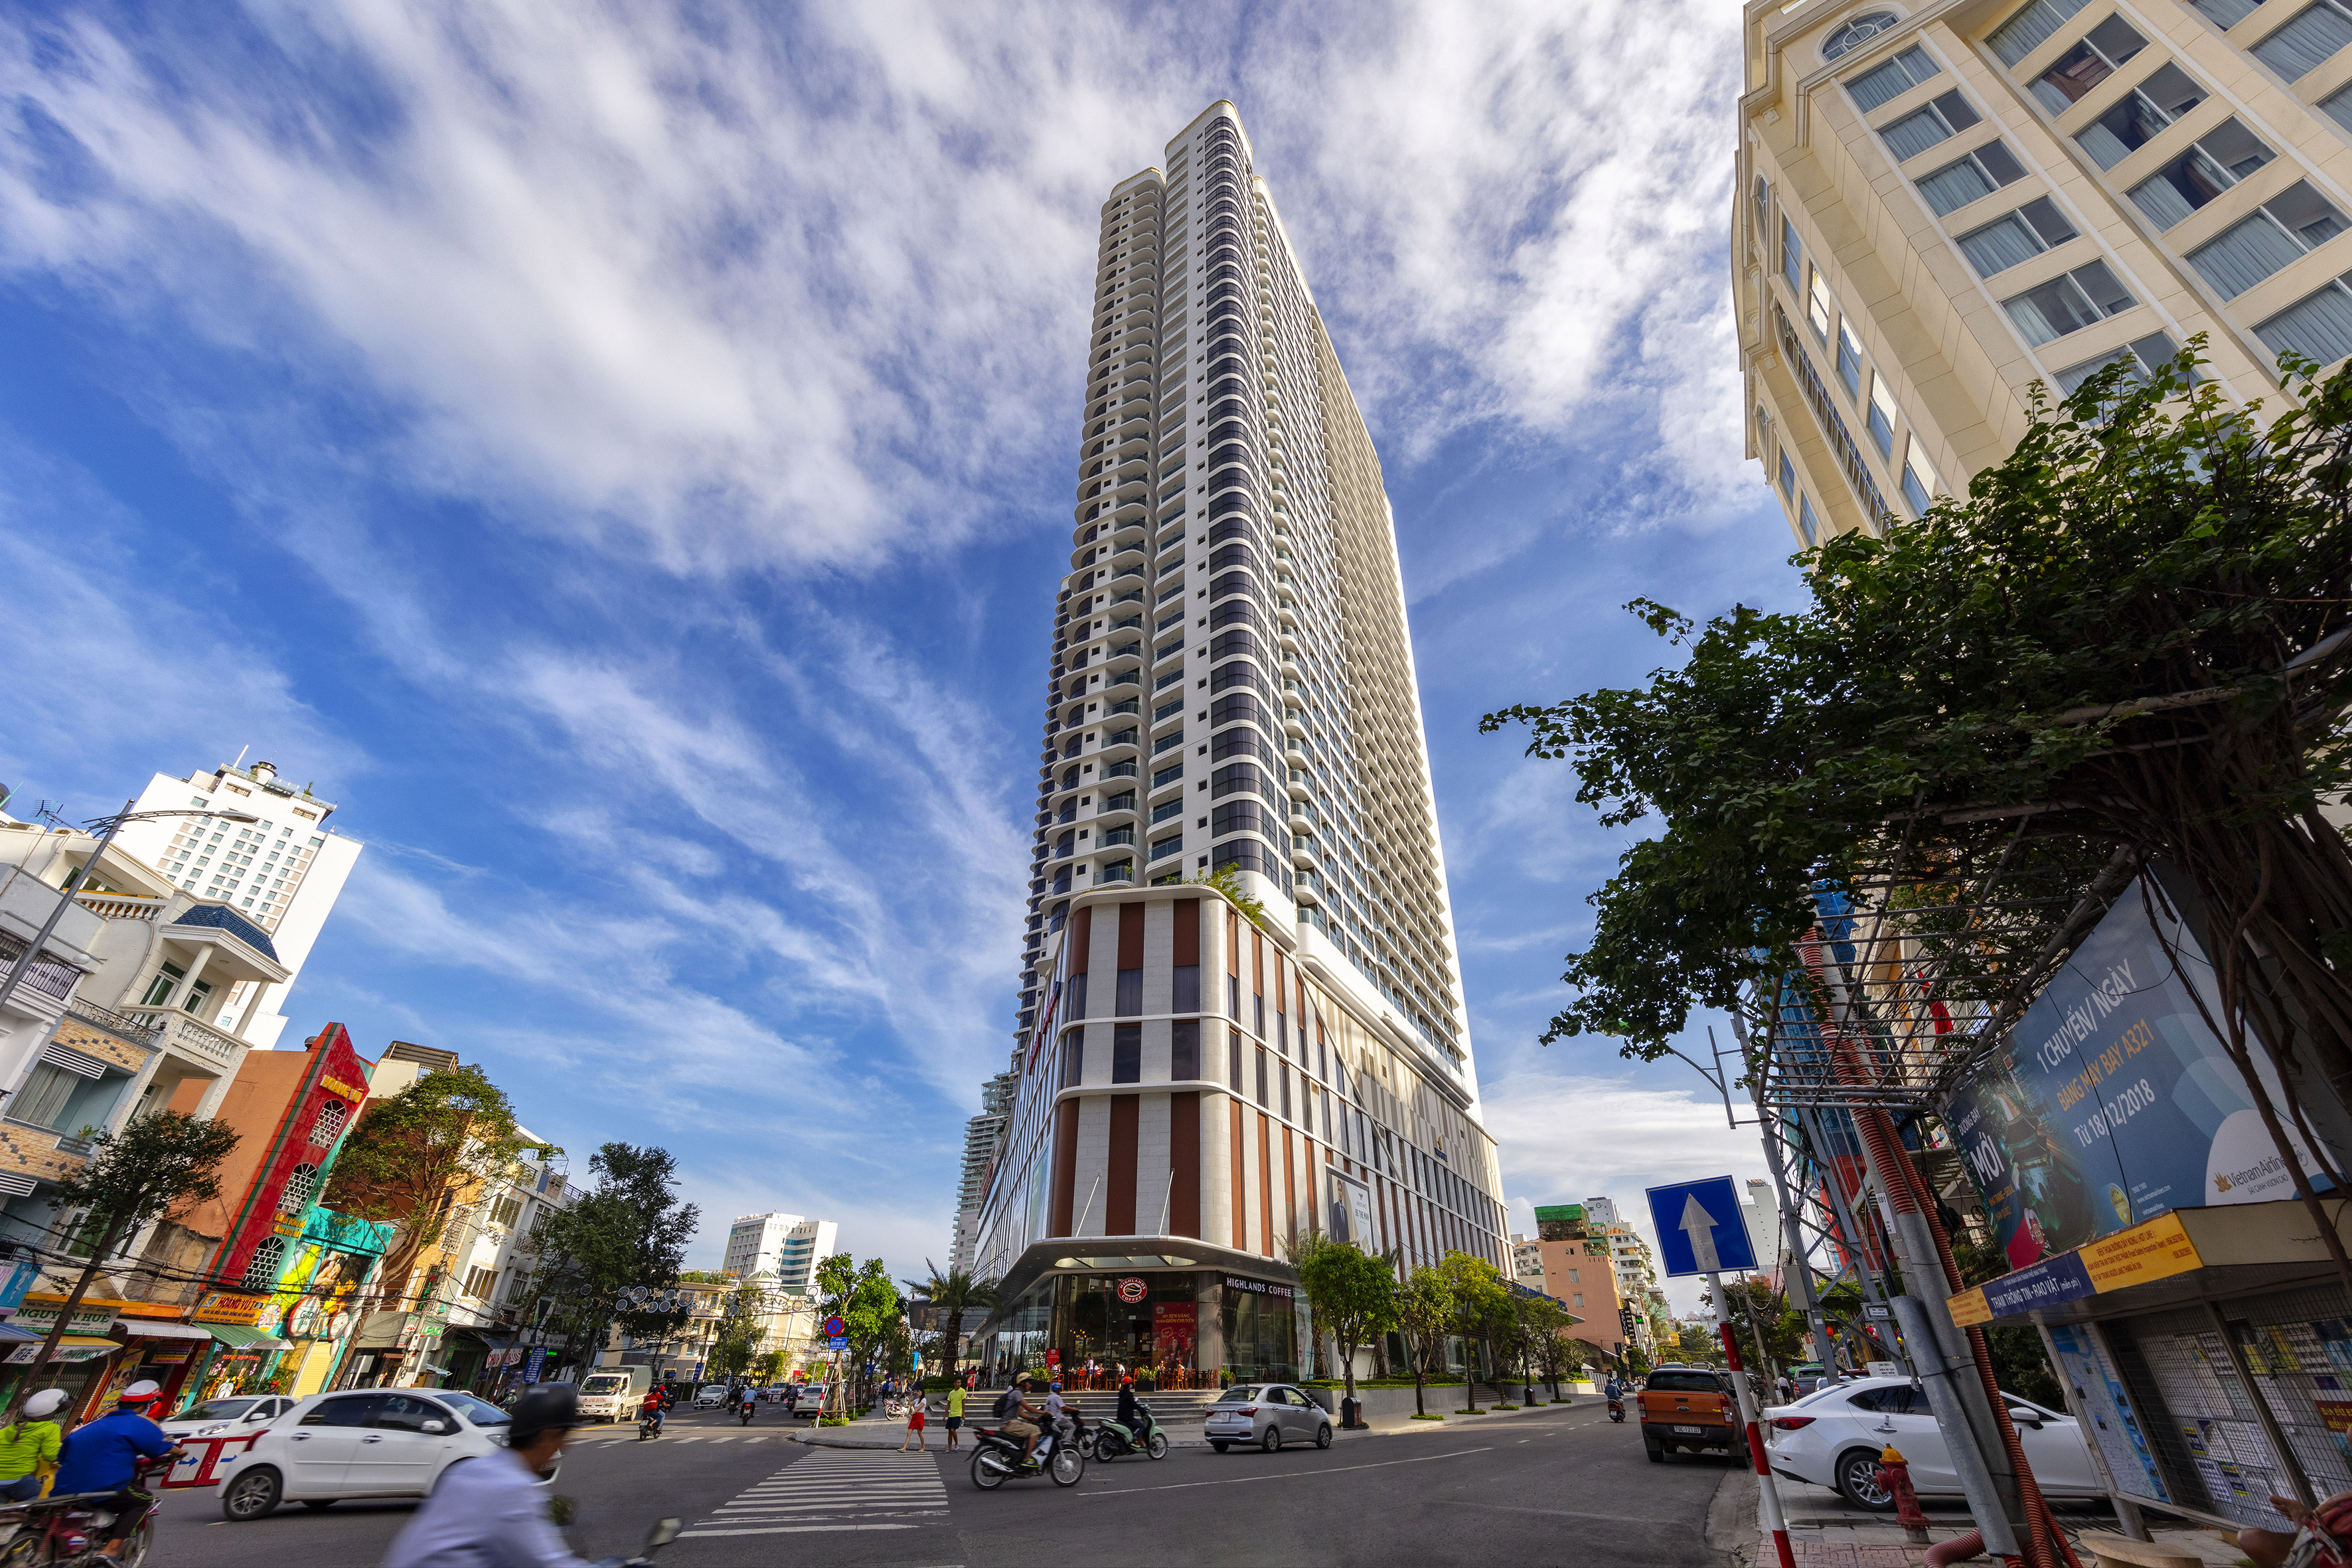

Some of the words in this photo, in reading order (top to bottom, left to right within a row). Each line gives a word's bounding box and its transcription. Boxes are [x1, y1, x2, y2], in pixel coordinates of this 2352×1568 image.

[2037, 1052, 2049, 1073] 1
[2092, 958, 2137, 1018] NGÀY
[2079, 1061, 2104, 1093] MÁY
[2099, 1041, 2124, 1075] BAY
[2121, 1018, 2154, 1059] A321
[319, 1074, 351, 1099] HOÀNG
[349, 1088, 364, 1103] VŨ
[1971, 1106, 1981, 1122] BAY
[2074, 1124, 2092, 1147] Từ
[2088, 1078, 2155, 1138] 18/12/2018
[1970, 1131, 2005, 1186] MỚI
[2260, 1156, 2288, 1176] Airline
[2278, 1173, 2289, 1184] CAO
[1120, 1279, 1146, 1290] HIGHLANDS
[1227, 1277, 1265, 1293] HIGHLANDS
[1269, 1285, 1291, 1297] COFFEE
[1990, 1294, 2007, 1311] TRẠM
[2001, 1285, 2023, 1305] THÔNG
[2019, 1286, 2033, 1300] TIN
[2031, 1281, 2048, 1297] RAO
[2042, 1273, 2062, 1296] VẶT
[216, 1296, 242, 1310] HOÀNG
[15, 1308, 80, 1321] NGUYN
[81, 1312, 111, 1324] HUỆ
[1620, 1310, 1628, 1335] CACTUS
[62, 1349, 102, 1361] PHARMACY
